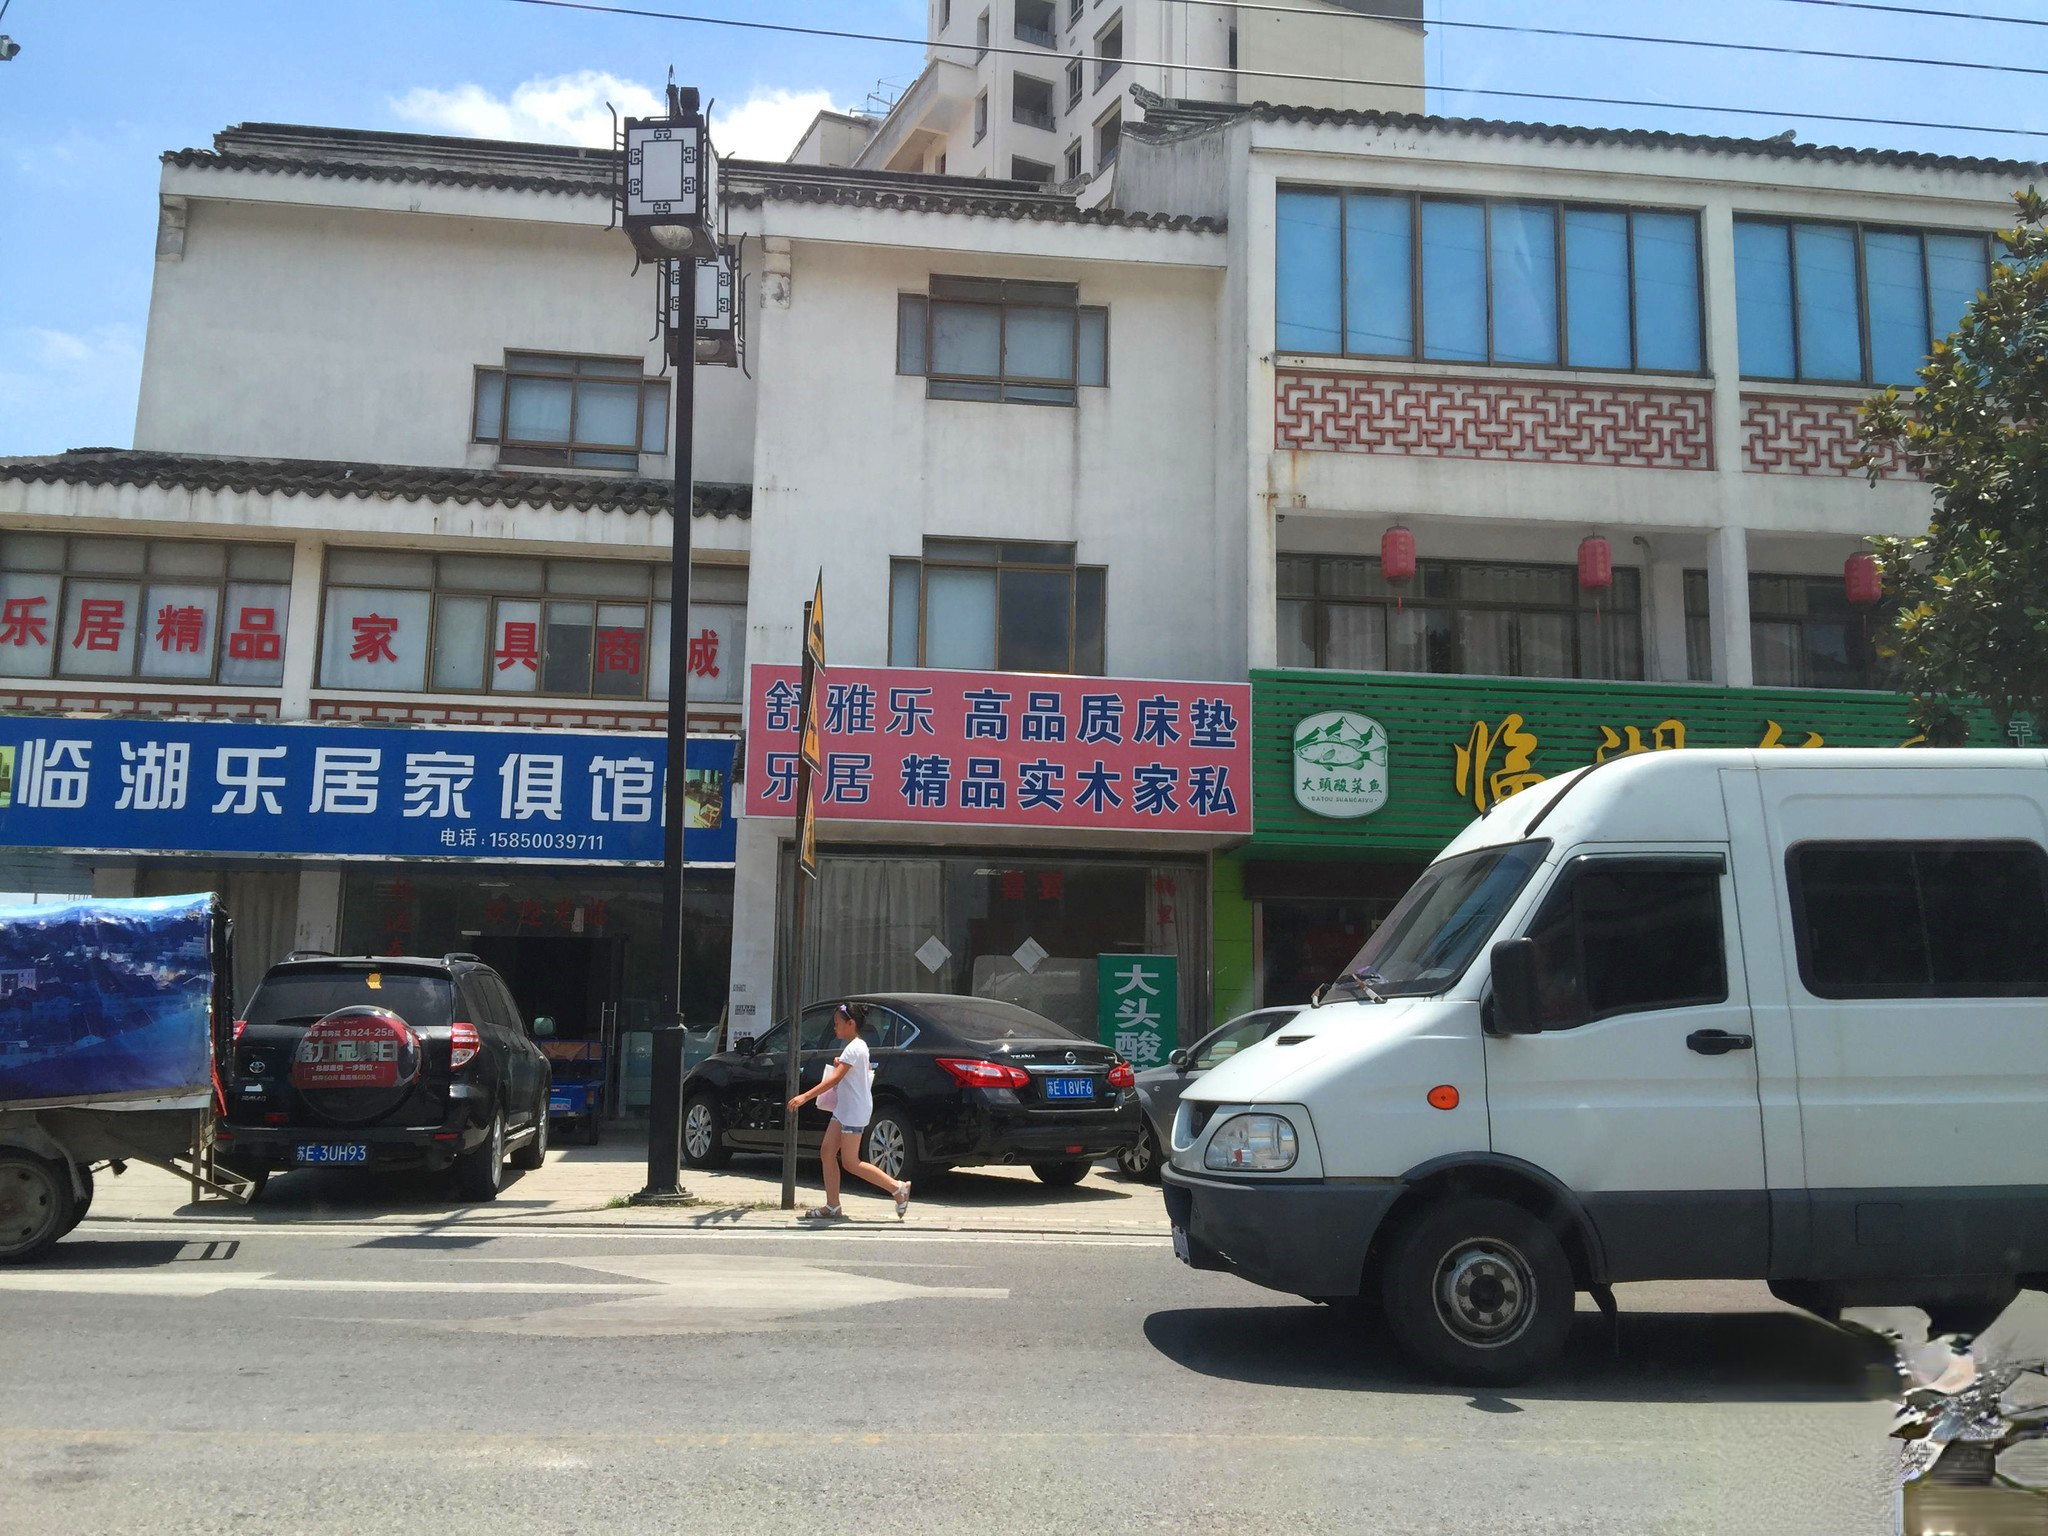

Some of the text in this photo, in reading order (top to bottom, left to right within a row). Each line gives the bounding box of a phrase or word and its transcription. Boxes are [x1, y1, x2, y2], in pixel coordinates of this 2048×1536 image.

[0, 596, 280, 660] 乐居精品
[765, 679, 1238, 749] 舒雅乐 高品质床垫
[17, 738, 655, 822] 临湖乐居家俱馆
[761, 753, 1239, 817] 乐居 精品实木家私
[1302, 777, 1383, 794] 大頭酸菜魚
[343, 1028, 395, 1038] 3月24-25日
[1114, 964, 1163, 1073] 大头酸
